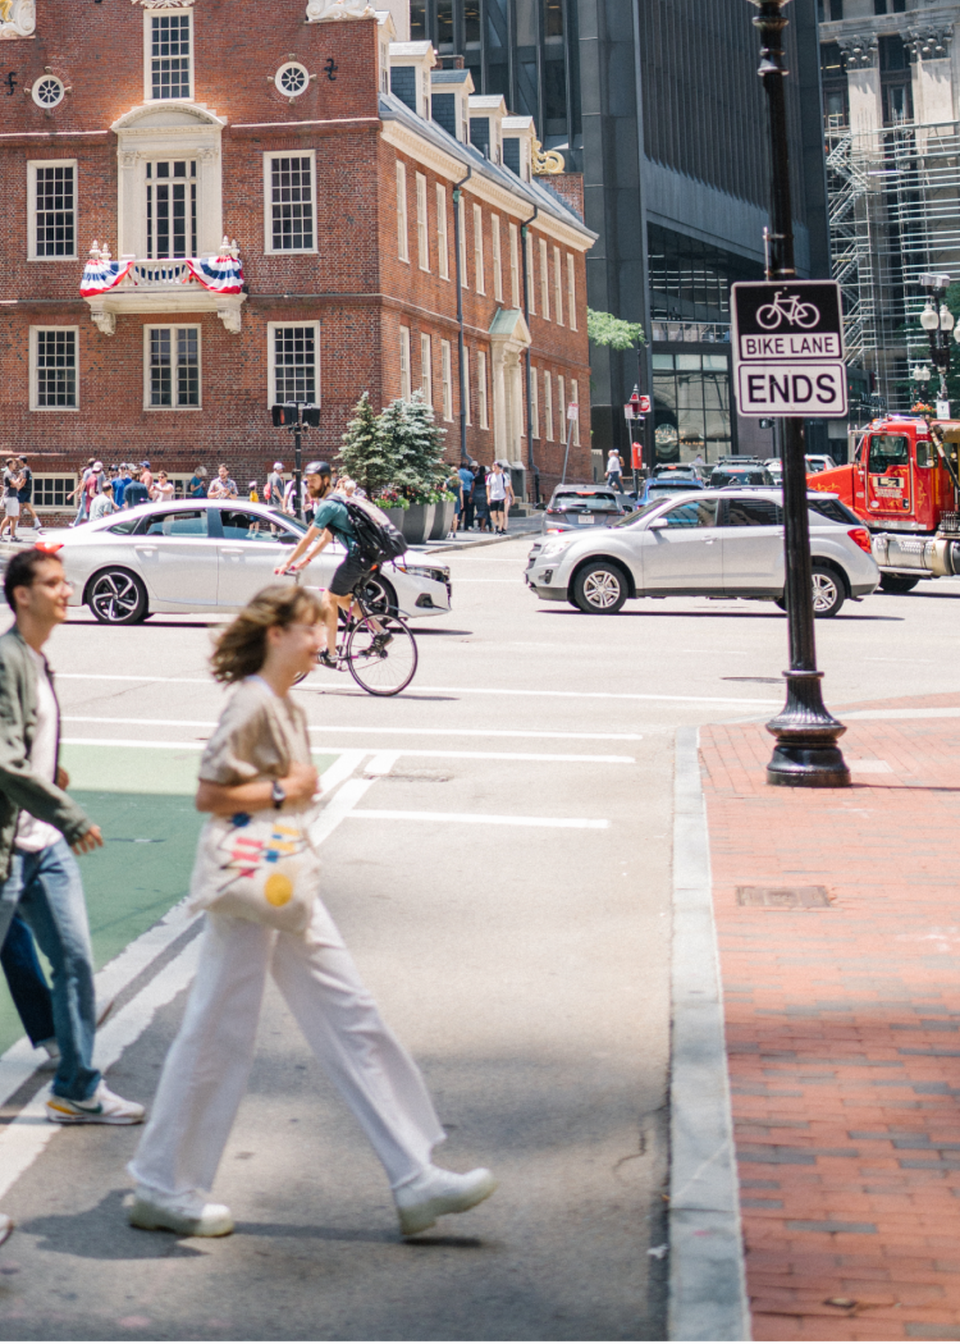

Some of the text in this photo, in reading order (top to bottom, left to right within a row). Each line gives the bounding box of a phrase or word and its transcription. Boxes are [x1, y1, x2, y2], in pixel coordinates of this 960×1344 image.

[746, 337, 834, 354] BIKE LANE
[748, 374, 836, 404] ENDS
